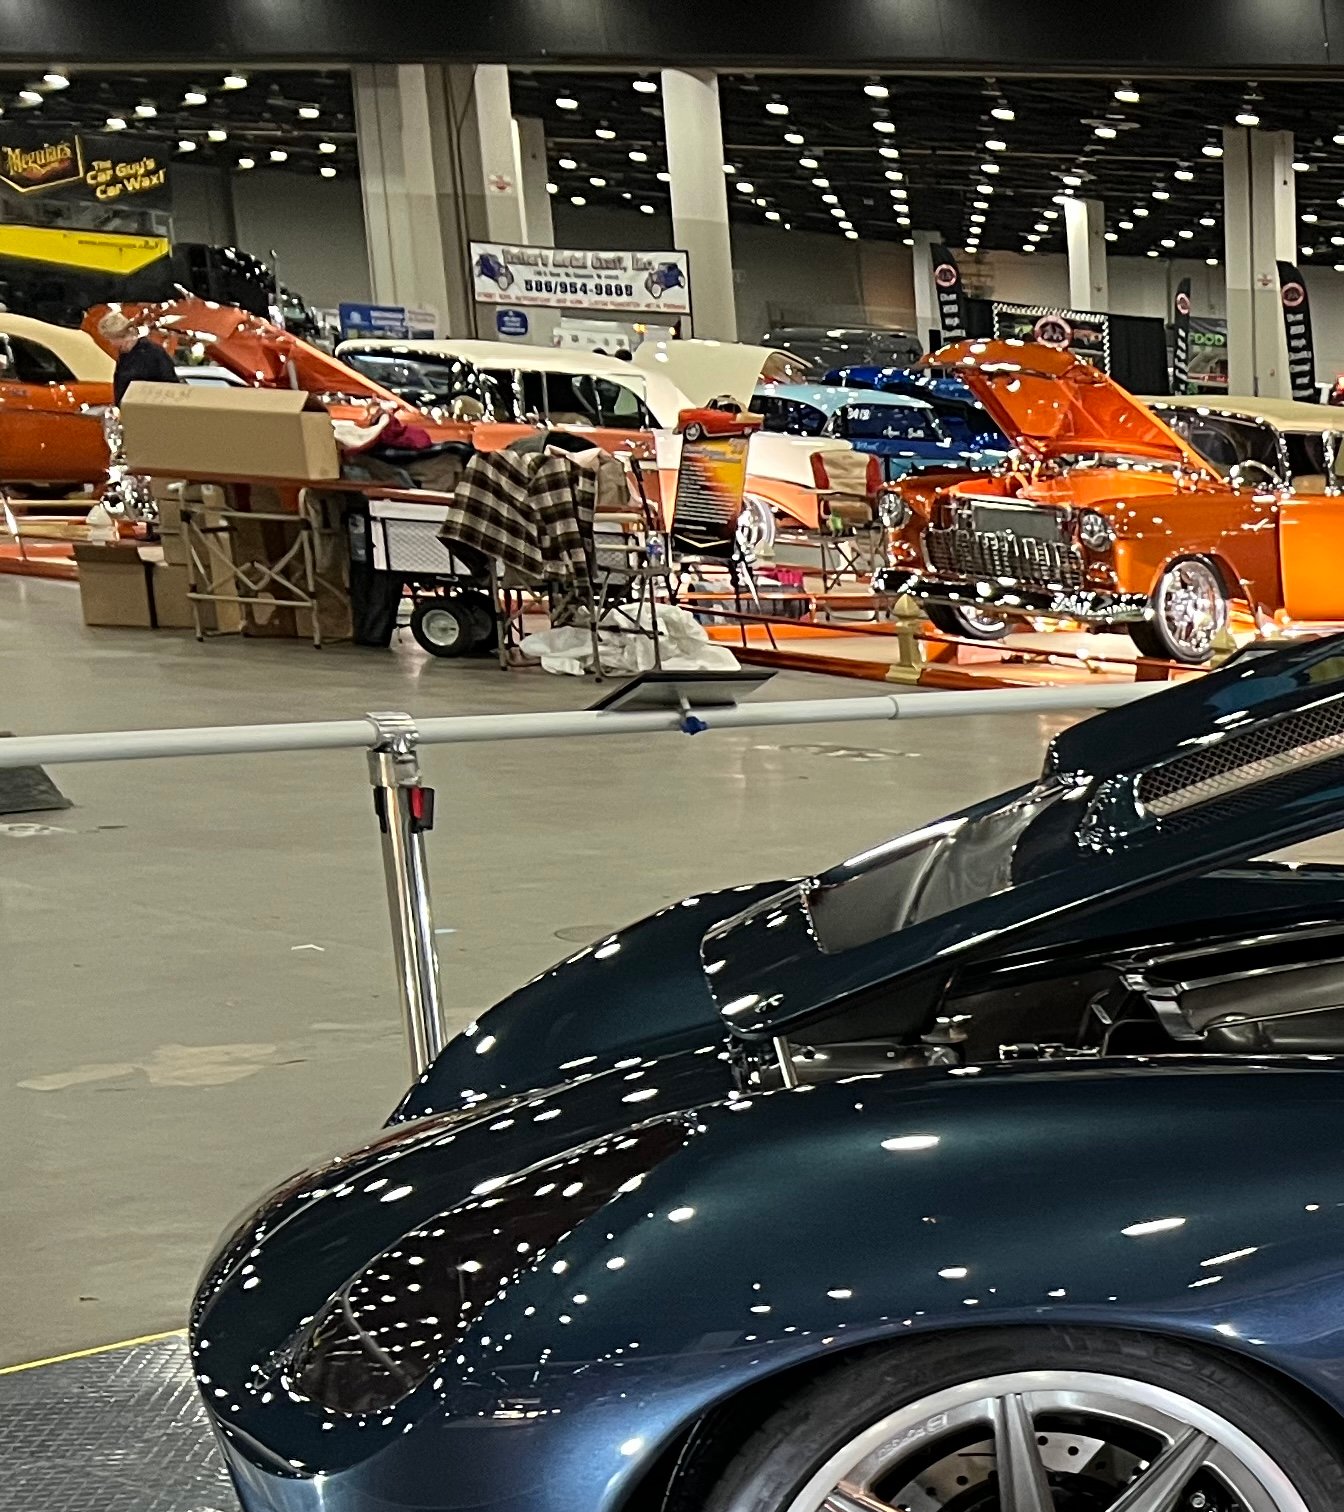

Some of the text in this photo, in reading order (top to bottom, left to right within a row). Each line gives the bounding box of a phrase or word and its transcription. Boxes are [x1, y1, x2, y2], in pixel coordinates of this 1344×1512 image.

[86, 157, 156, 184] Car Guy's
[96, 183, 123, 199] Car
